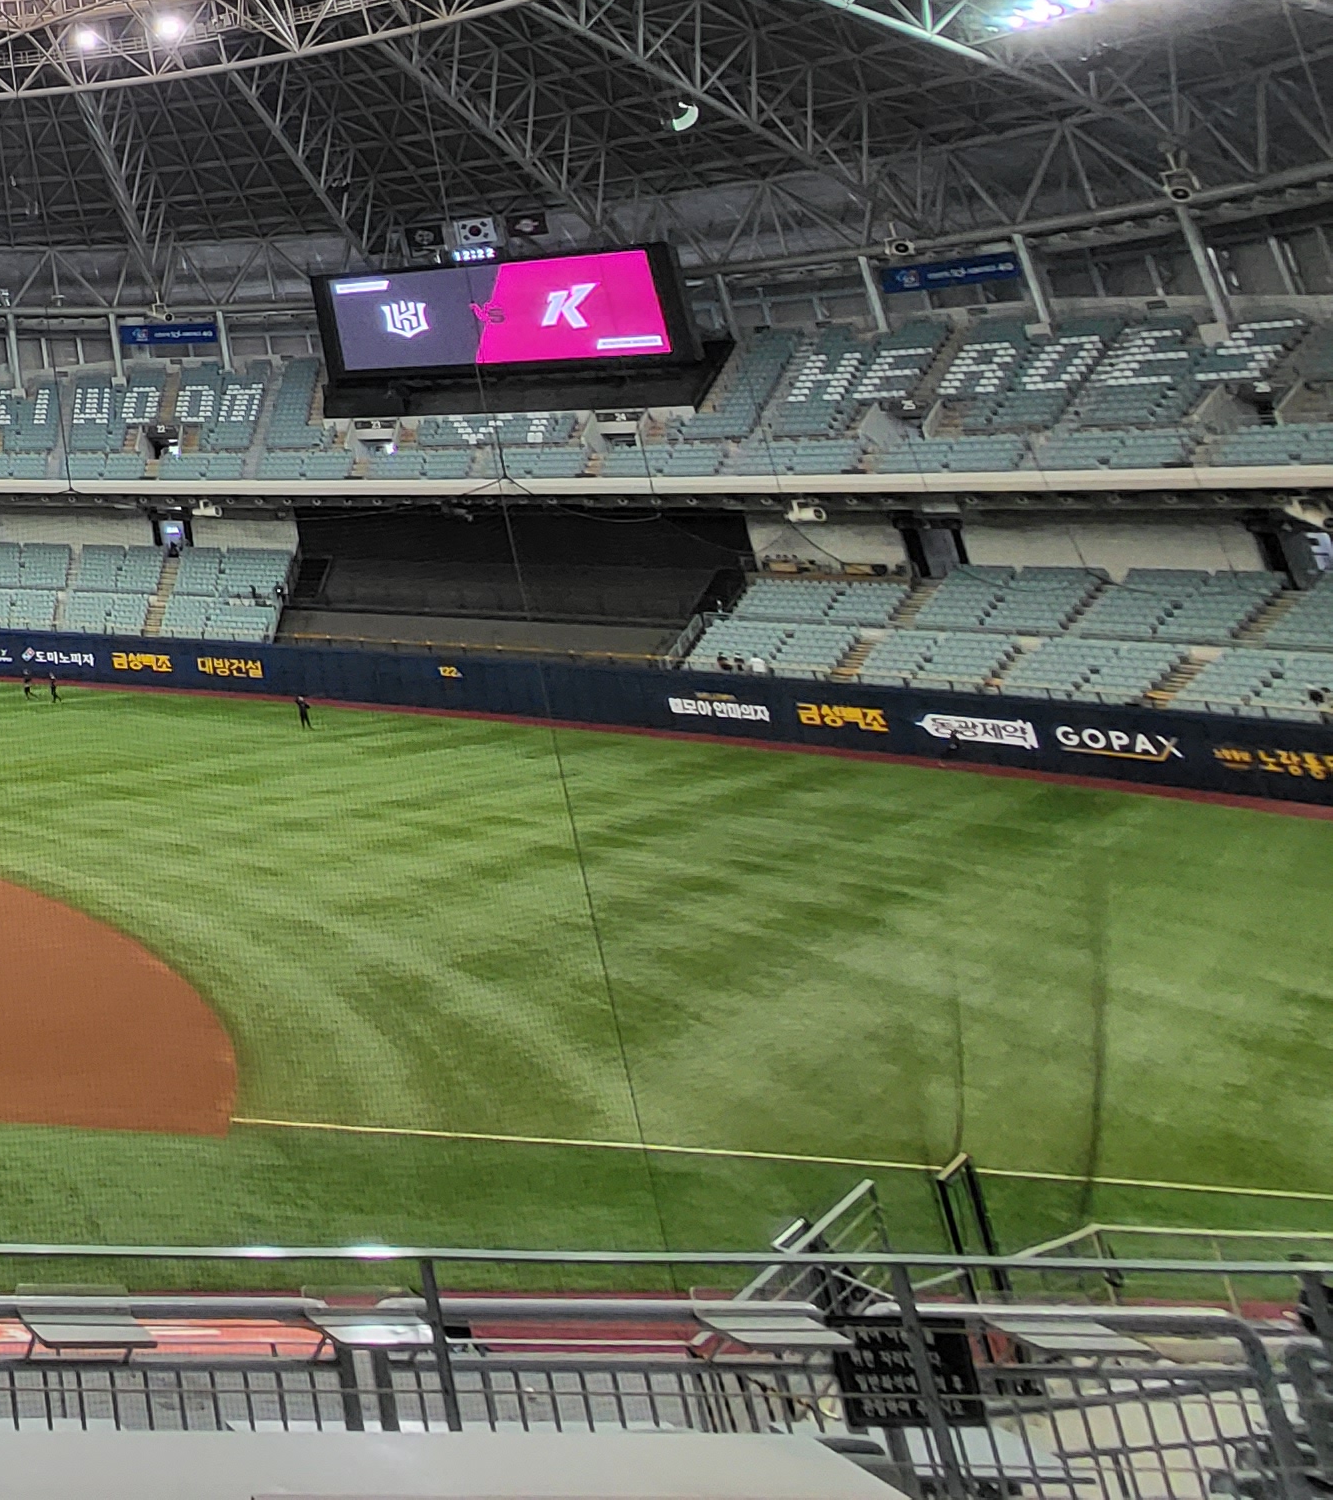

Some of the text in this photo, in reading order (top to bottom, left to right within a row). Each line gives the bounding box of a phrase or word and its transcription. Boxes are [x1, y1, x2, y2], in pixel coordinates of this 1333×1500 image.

[454, 248, 496, 261] 12:22
[35, 651, 95, 667] 도미노피자
[112, 653, 173, 672] 금성백조
[197, 656, 264, 679] 대방건설
[713, 700, 770, 723] 안마의자
[796, 702, 890, 733] 금성백조
[931, 717, 1029, 739] 동광제약
[1055, 725, 1184, 758] GOPAX
